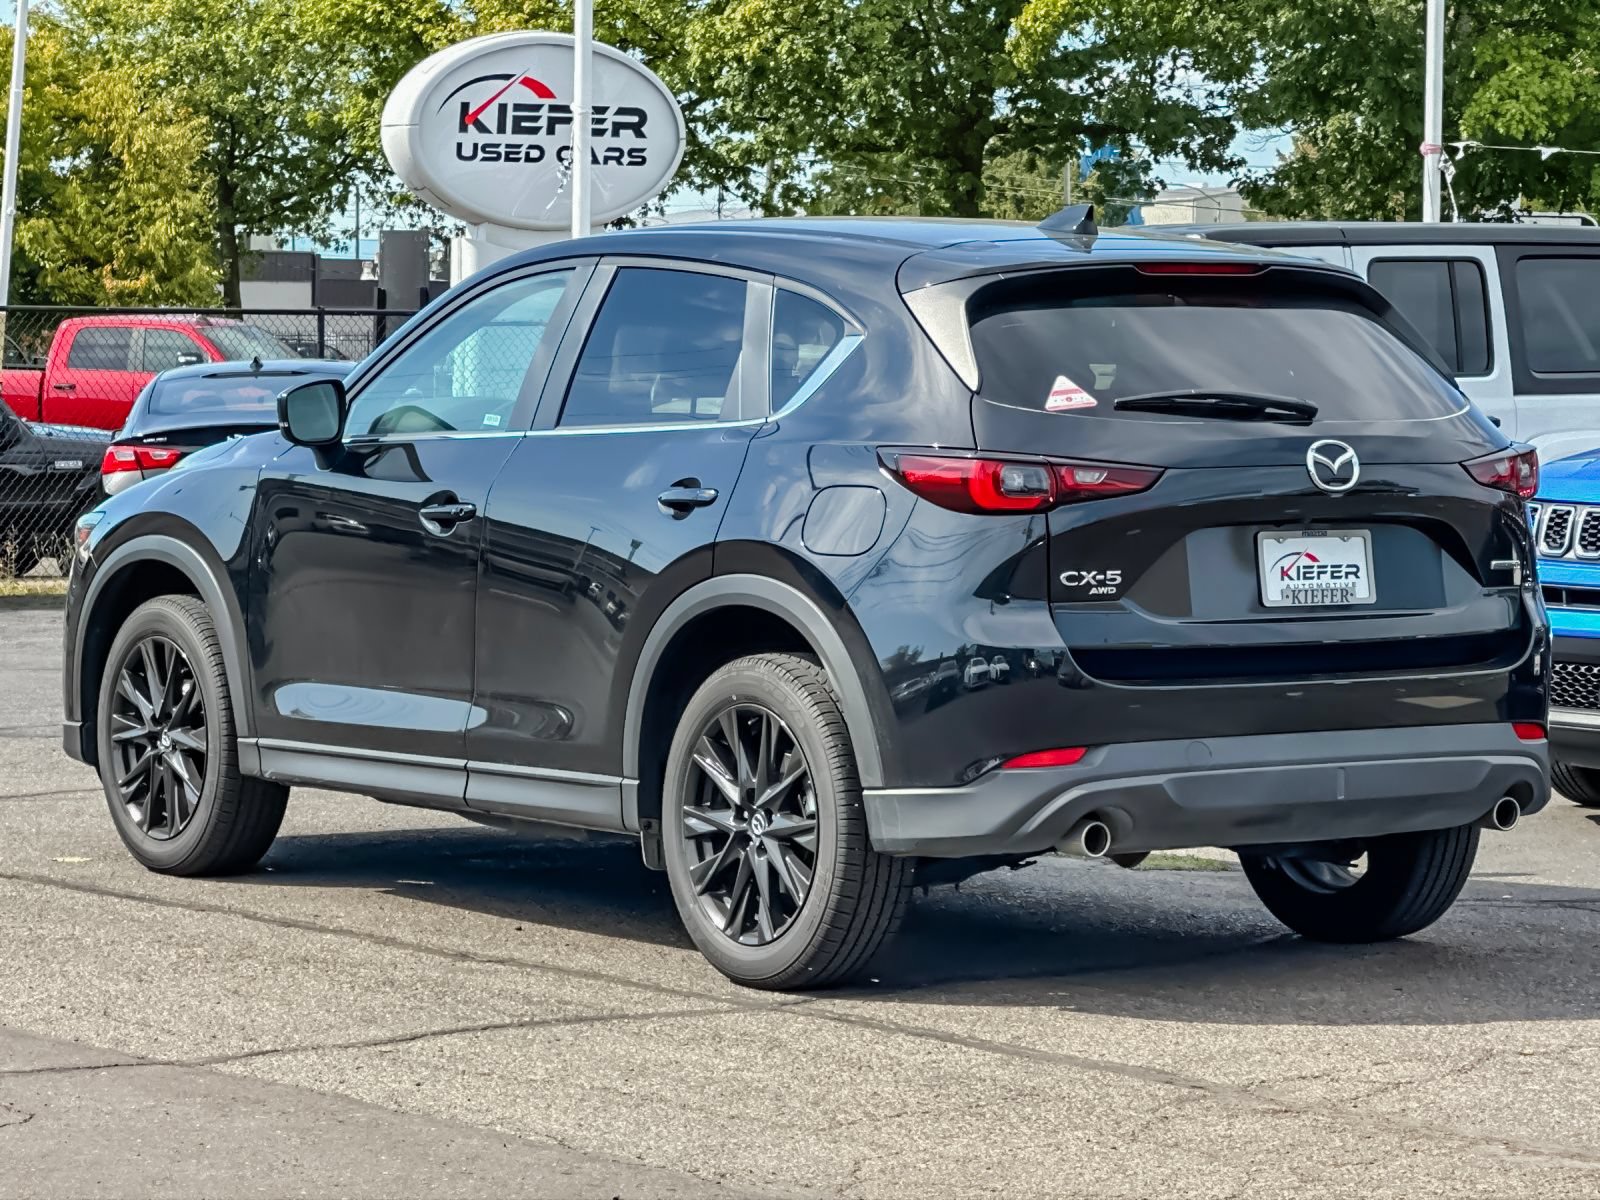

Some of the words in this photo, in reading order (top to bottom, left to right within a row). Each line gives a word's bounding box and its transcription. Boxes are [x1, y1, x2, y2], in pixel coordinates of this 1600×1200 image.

[456, 141, 545, 163] USED
[1060, 570, 1122, 587] CX-5
[1280, 563, 1361, 582] KIEFER
[1088, 586, 1117, 595] AWD
[1291, 587, 1351, 605] KIEFER
